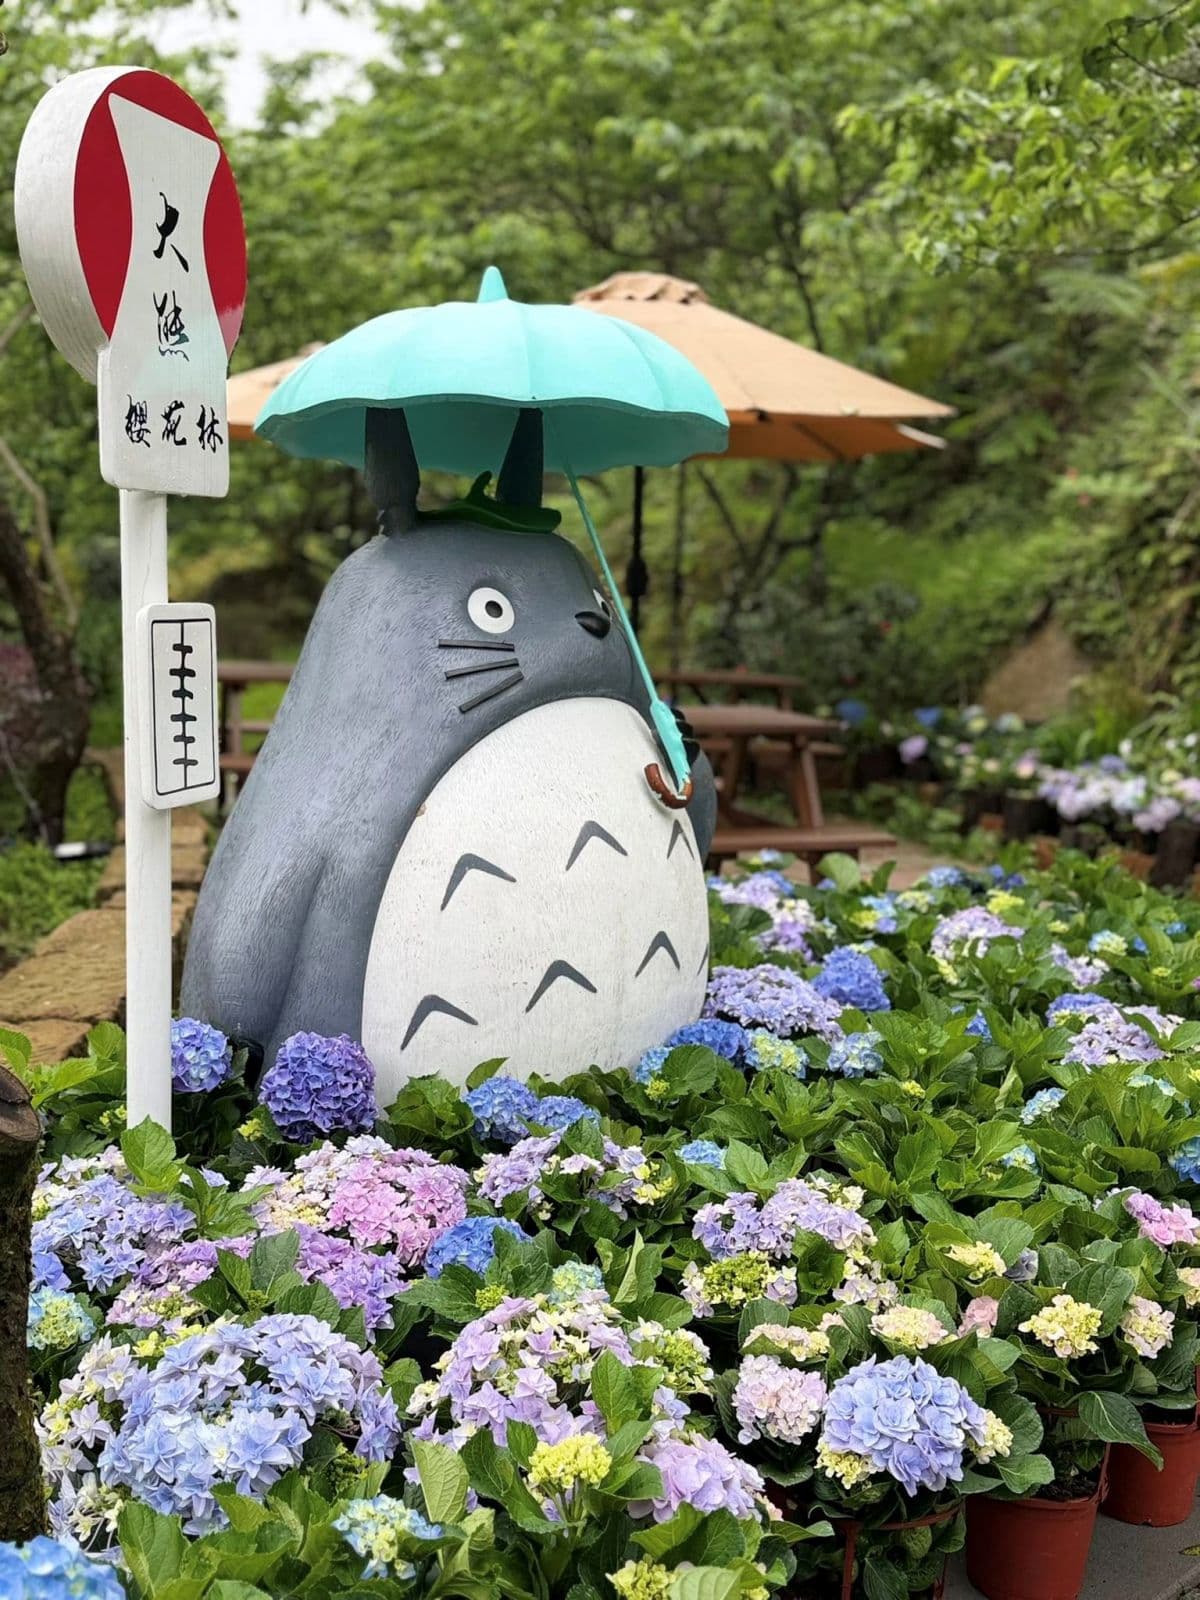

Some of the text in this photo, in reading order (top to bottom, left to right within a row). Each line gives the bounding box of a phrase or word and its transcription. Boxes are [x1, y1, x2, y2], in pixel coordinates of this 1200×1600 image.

[152, 191, 190, 362] 大熊
[124, 394, 224, 454] 櫻花林
